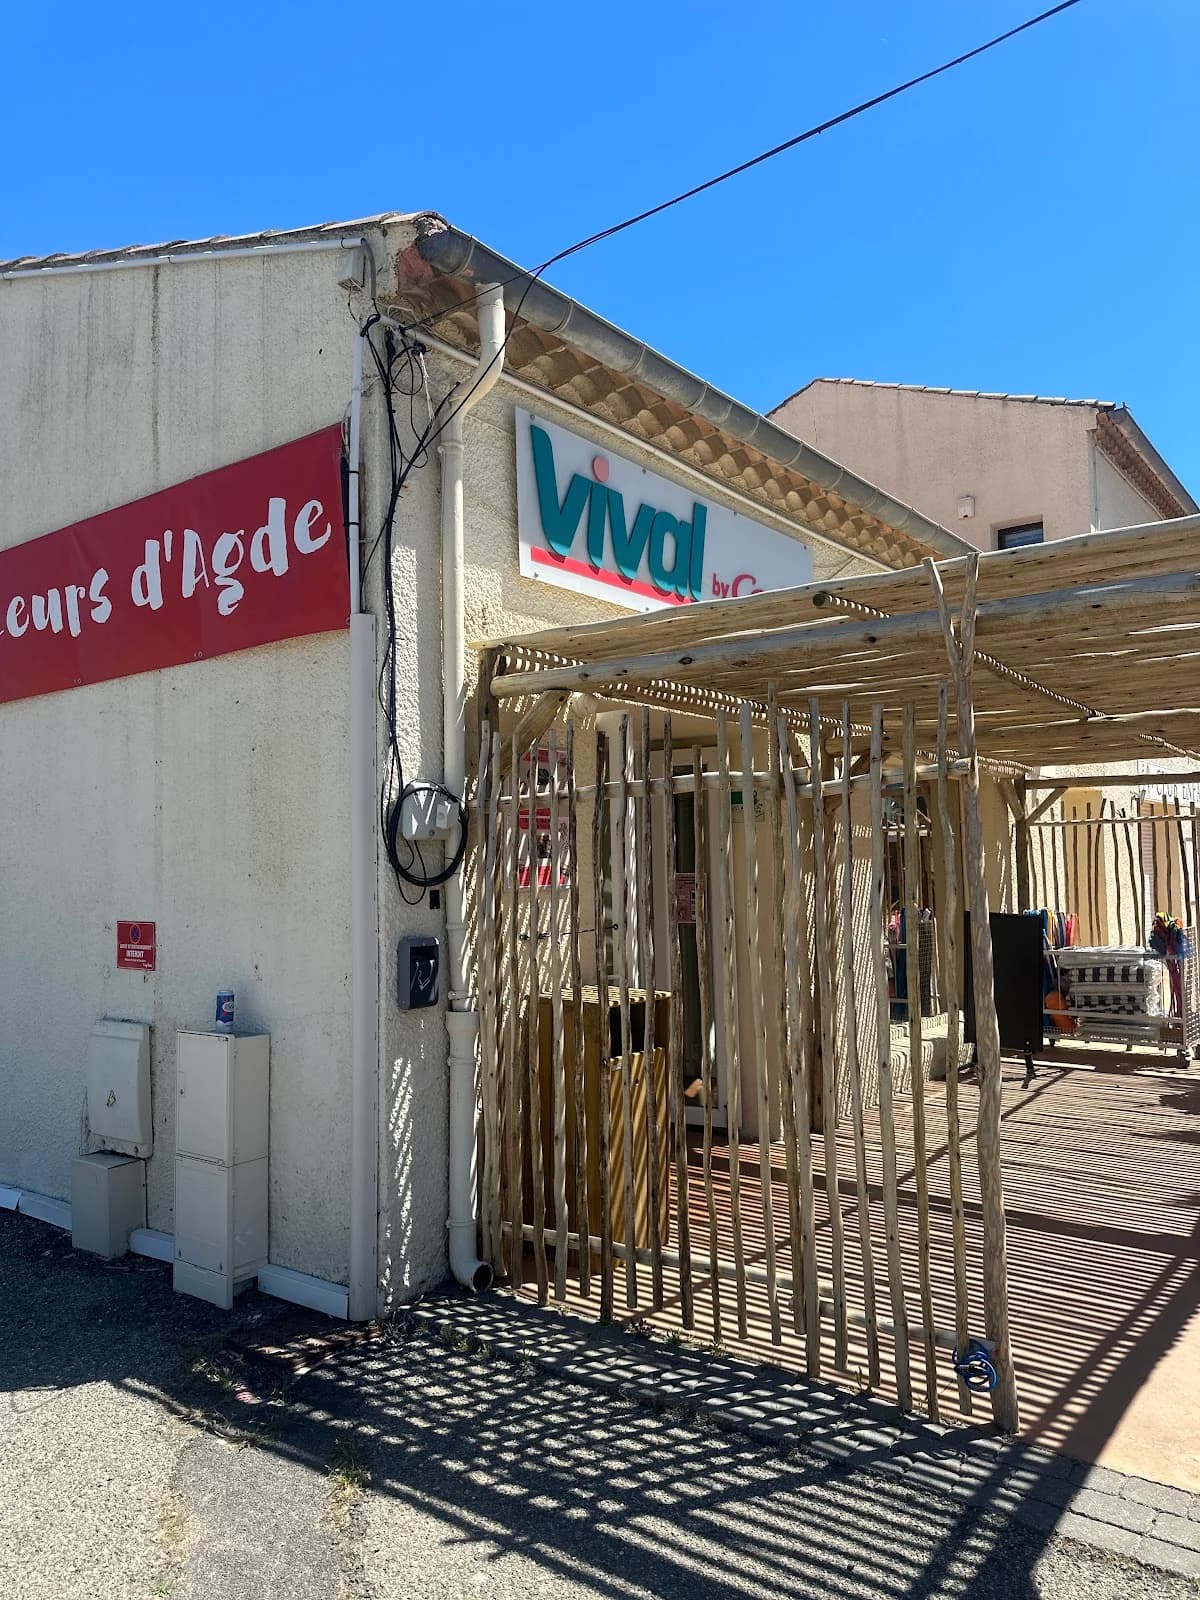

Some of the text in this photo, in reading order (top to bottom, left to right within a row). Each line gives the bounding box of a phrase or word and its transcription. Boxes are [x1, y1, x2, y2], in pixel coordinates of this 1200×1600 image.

[0, 497, 331, 637] eurs d'Agde
[530, 424, 708, 602] Vival
[712, 573, 730, 598] by
